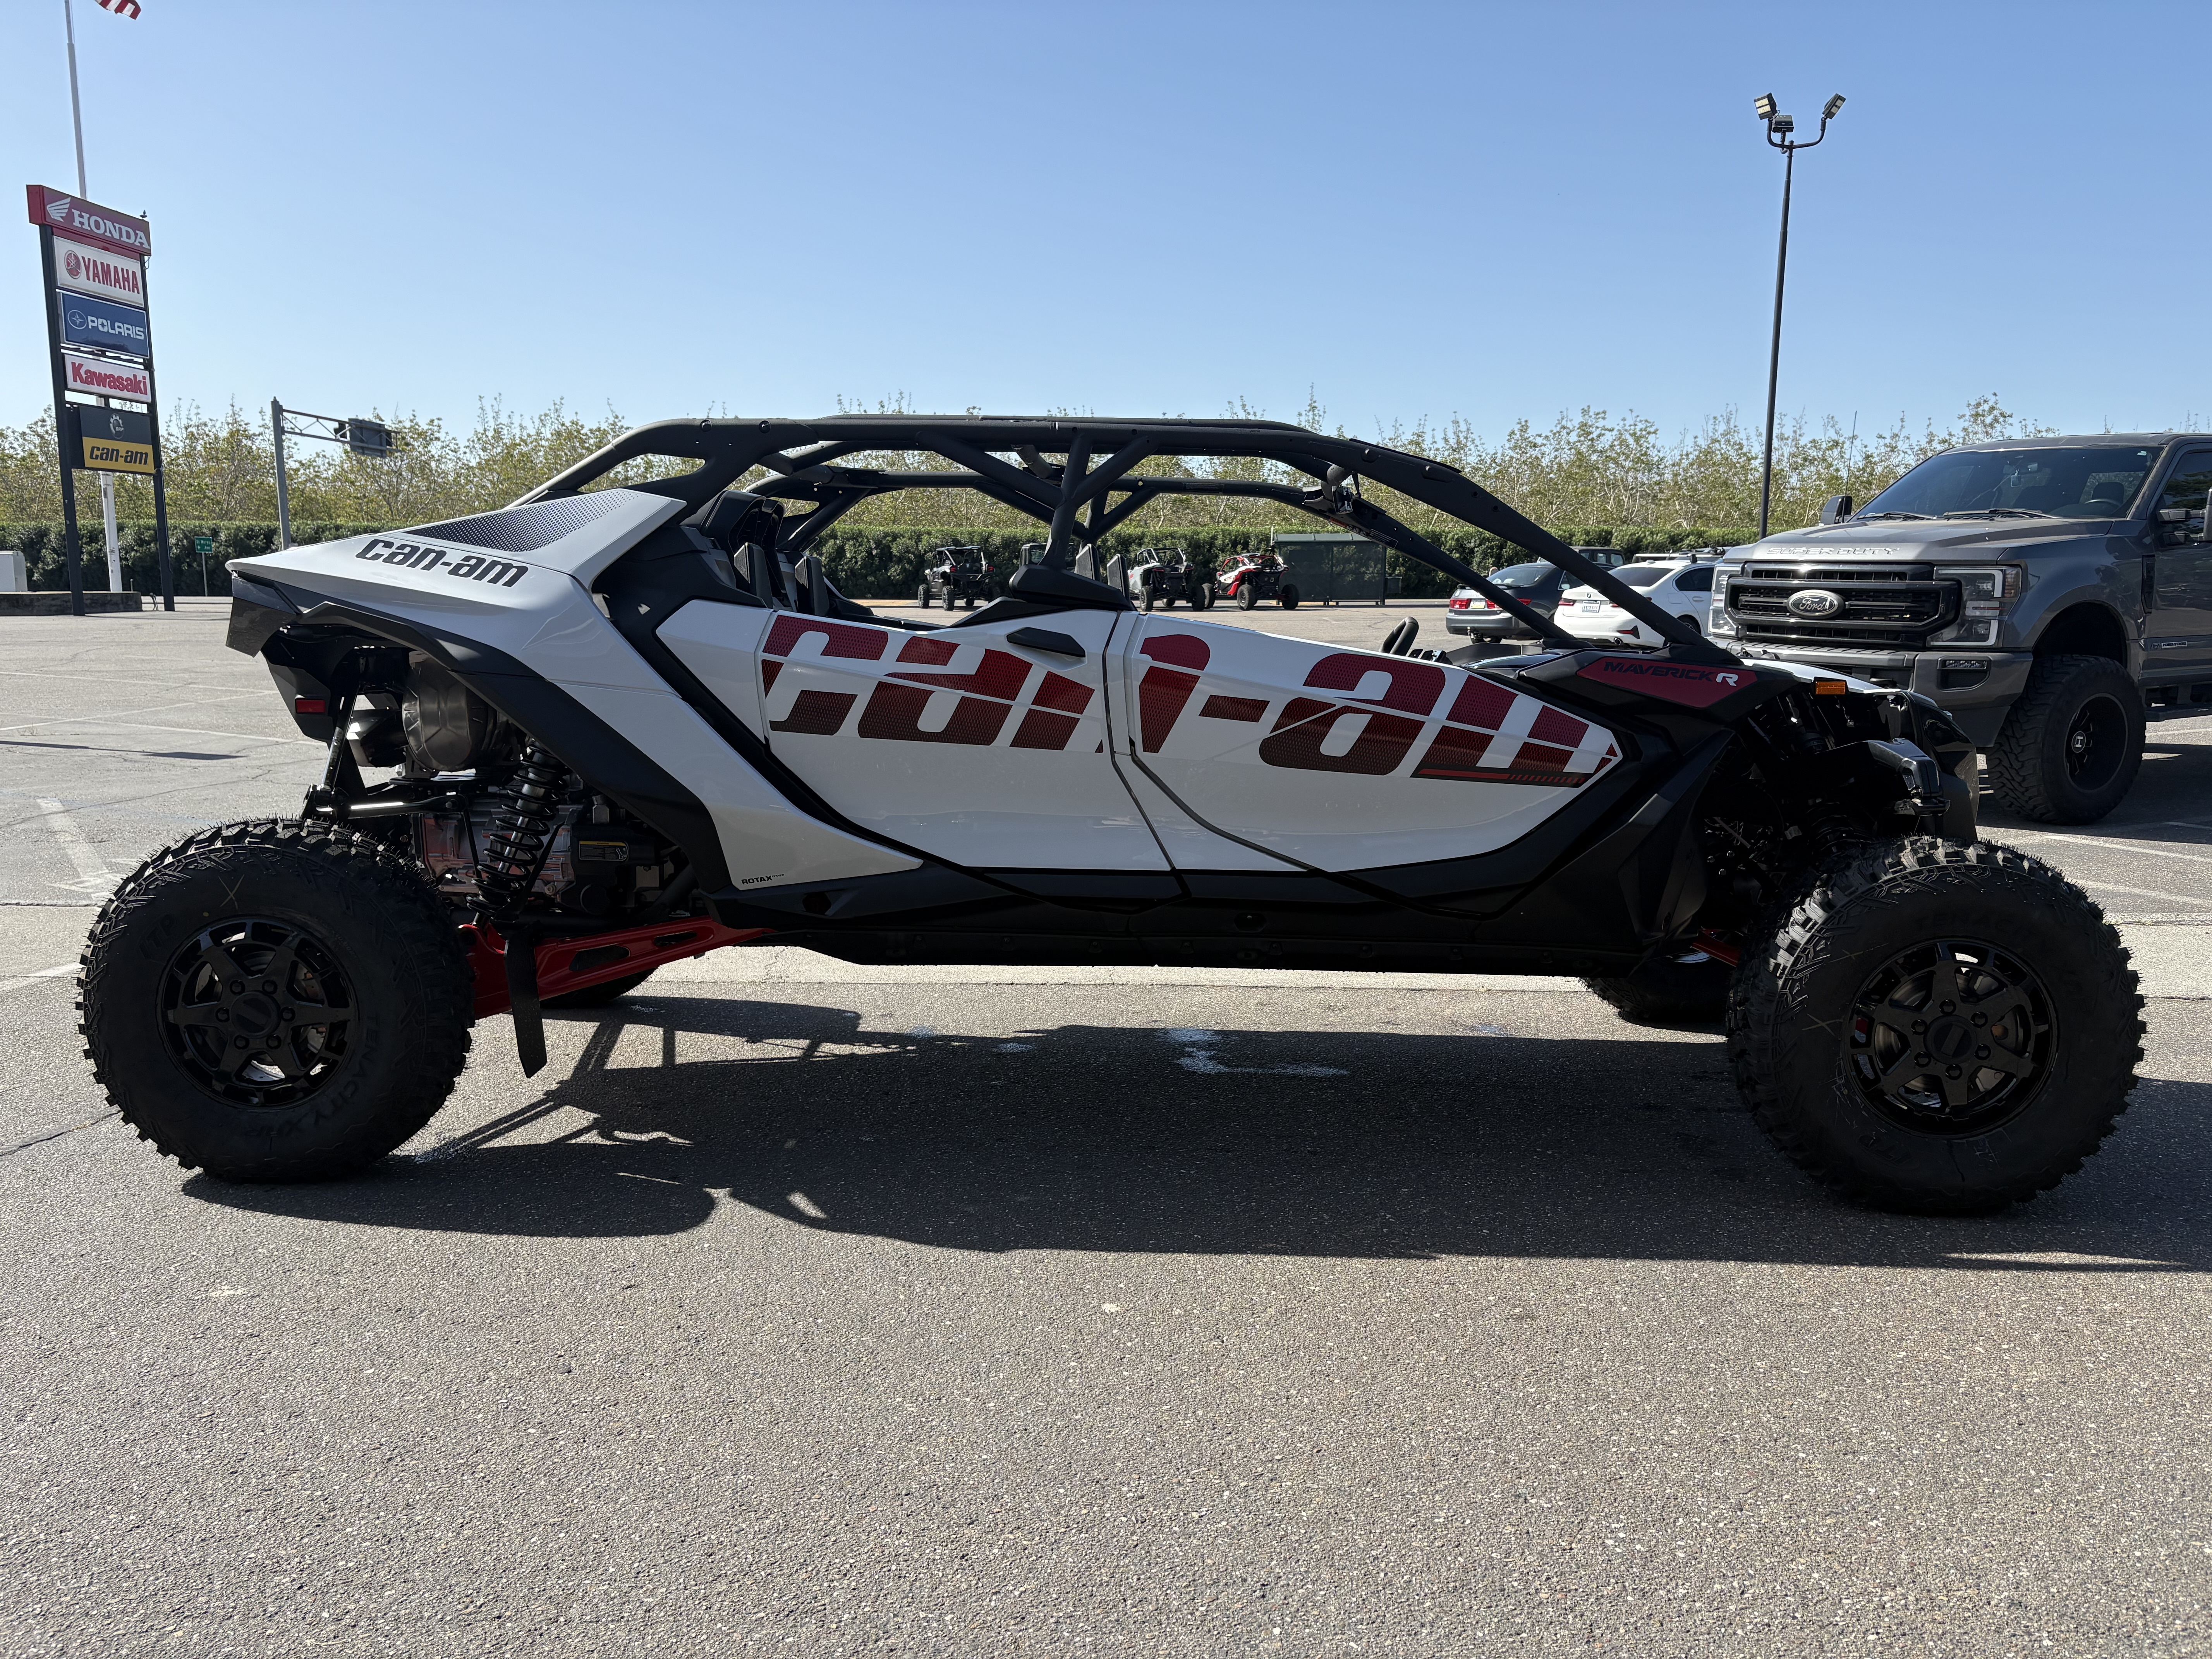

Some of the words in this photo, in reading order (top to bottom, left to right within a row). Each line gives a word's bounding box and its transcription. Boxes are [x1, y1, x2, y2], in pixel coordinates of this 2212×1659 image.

[72, 210, 151, 249] HONDA
[81, 256, 140, 294] YAMAHA
[88, 315, 144, 340] POLARIS
[71, 362, 147, 395] Kawasaki
[89, 446, 149, 465] can-am
[356, 539, 529, 587] can-am
[1767, 547, 1834, 555] SUPER
[1799, 595, 1831, 610] Ford
[1604, 661, 1714, 682] MAVERICK
[1716, 673, 1738, 687] R
[741, 876, 773, 885] ROTAX
[139, 914, 175, 959] ITP
[314, 1013, 380, 1125] TENACITY
